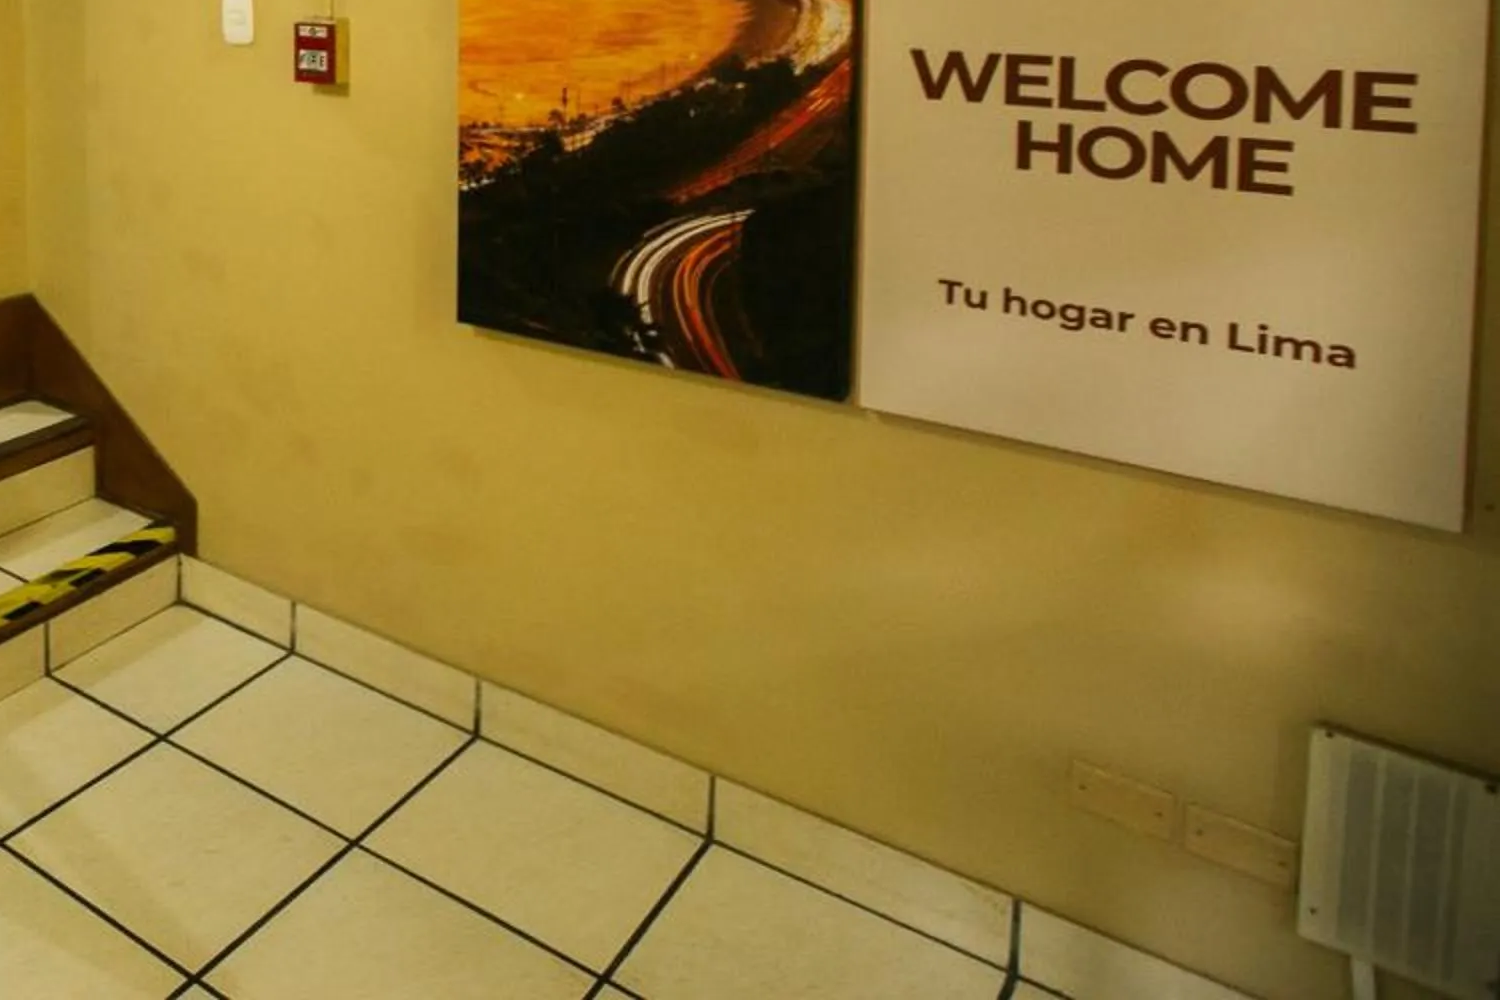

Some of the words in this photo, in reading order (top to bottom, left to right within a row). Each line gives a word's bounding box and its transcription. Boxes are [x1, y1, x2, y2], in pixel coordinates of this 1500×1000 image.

[909, 47, 1419, 135] WELCOME
[1015, 120, 1295, 197] HOME
[937, 278, 989, 311] Tu
[1002, 286, 1135, 332] hogar
[1148, 316, 1209, 345] en
[1227, 321, 1357, 370] Lima
